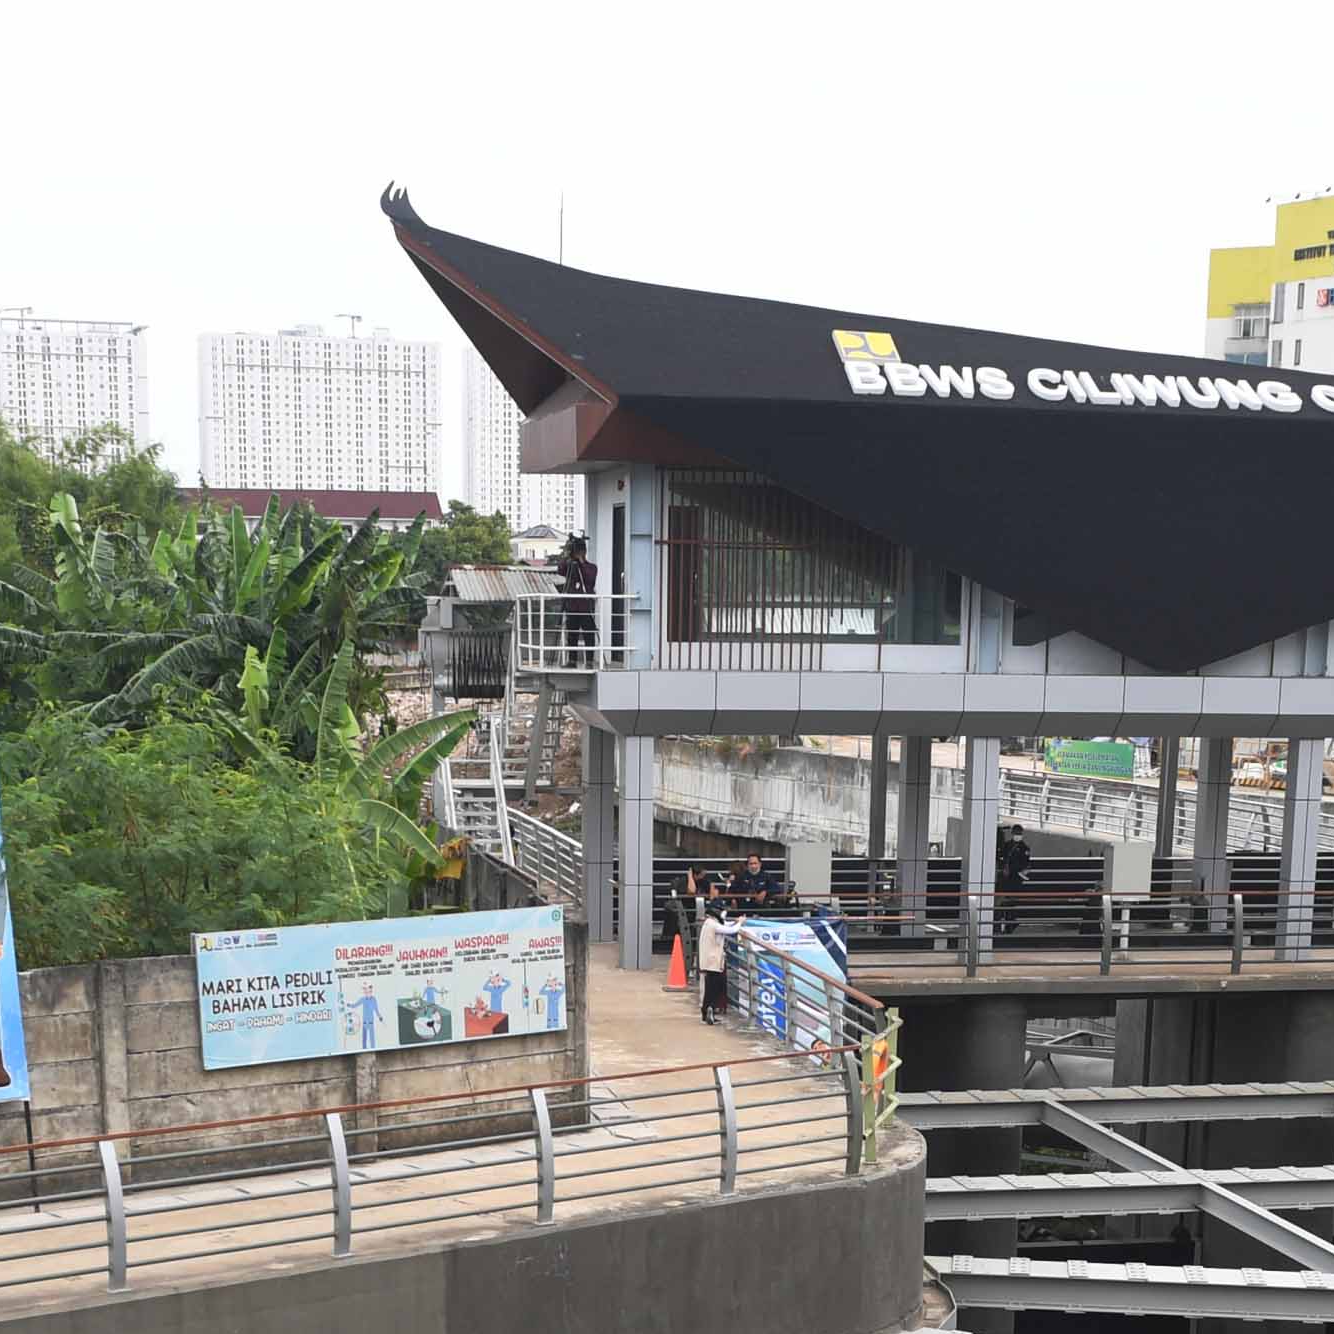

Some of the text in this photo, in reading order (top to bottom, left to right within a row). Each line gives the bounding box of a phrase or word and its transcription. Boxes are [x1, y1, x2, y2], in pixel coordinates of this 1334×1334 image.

[844, 361, 1015, 400] BBWS
[1027, 367, 1303, 413] CILIWUNG
[202, 978, 243, 996] MARI
[247, 975, 281, 992] KITA
[284, 969, 333, 988] PEDULI
[212, 990, 326, 1014] BAHAYA LISTRIK
